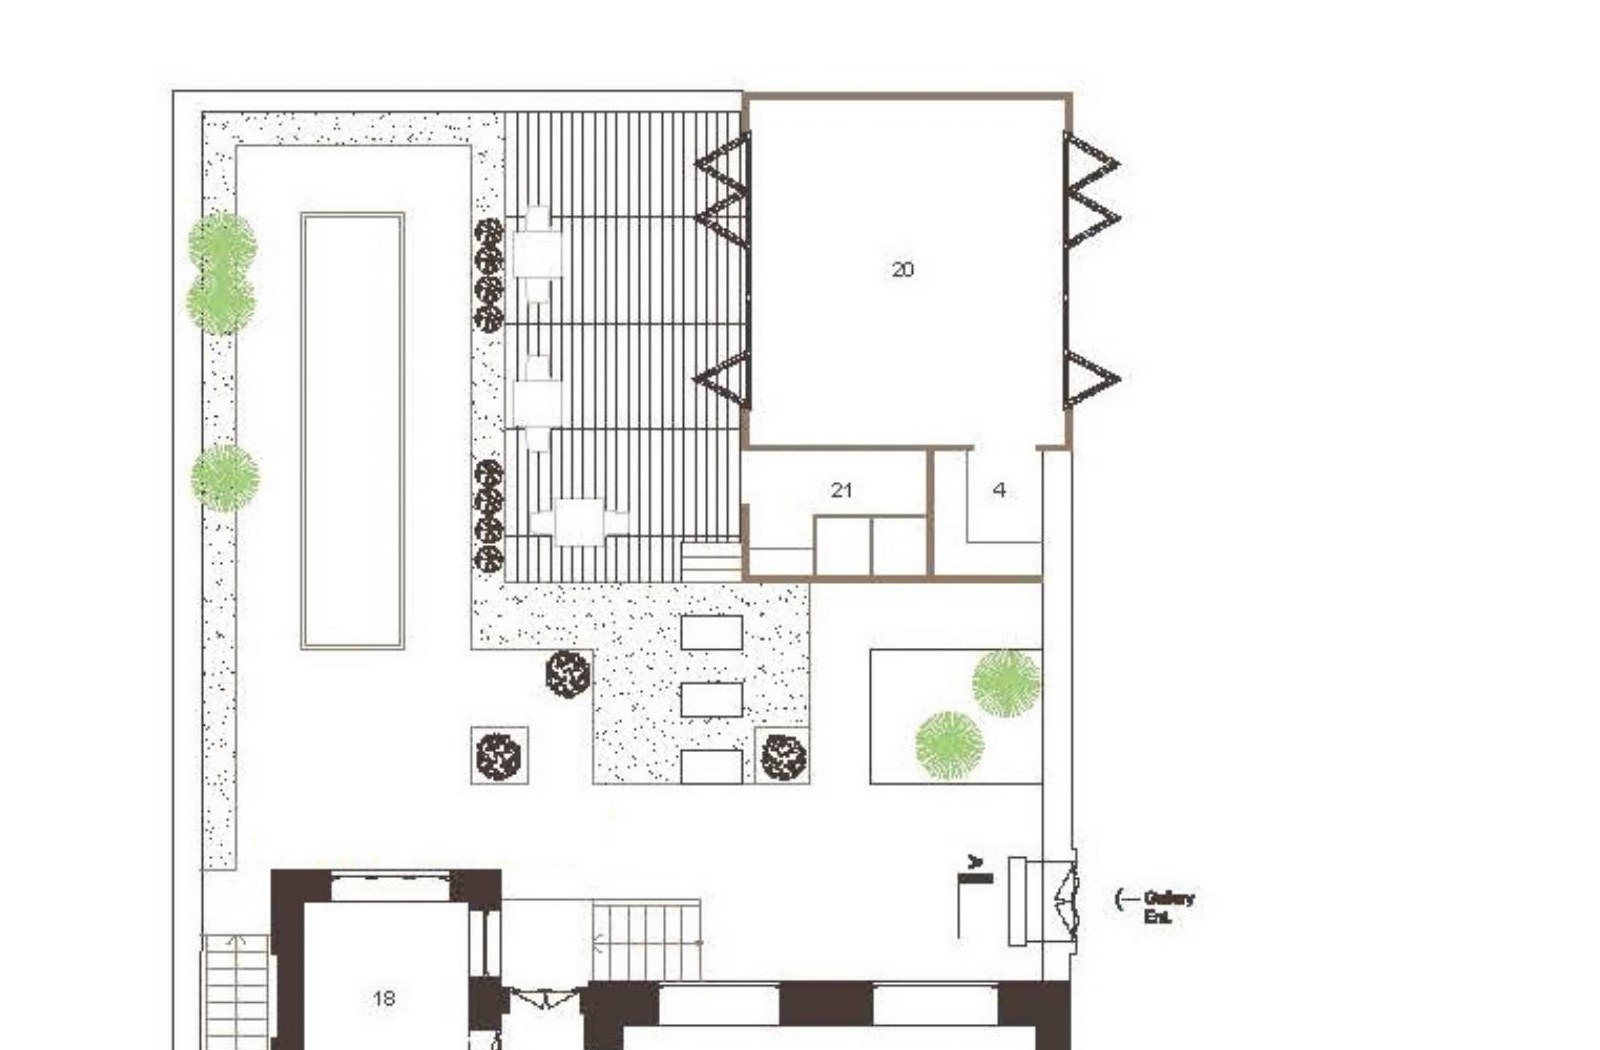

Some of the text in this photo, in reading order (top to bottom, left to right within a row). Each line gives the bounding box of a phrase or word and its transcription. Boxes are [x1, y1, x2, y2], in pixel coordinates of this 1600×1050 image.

[892, 261, 915, 278] 20
[831, 482, 852, 498] 21
[992, 482, 1006, 498] 4
[373, 990, 396, 1007] 18
